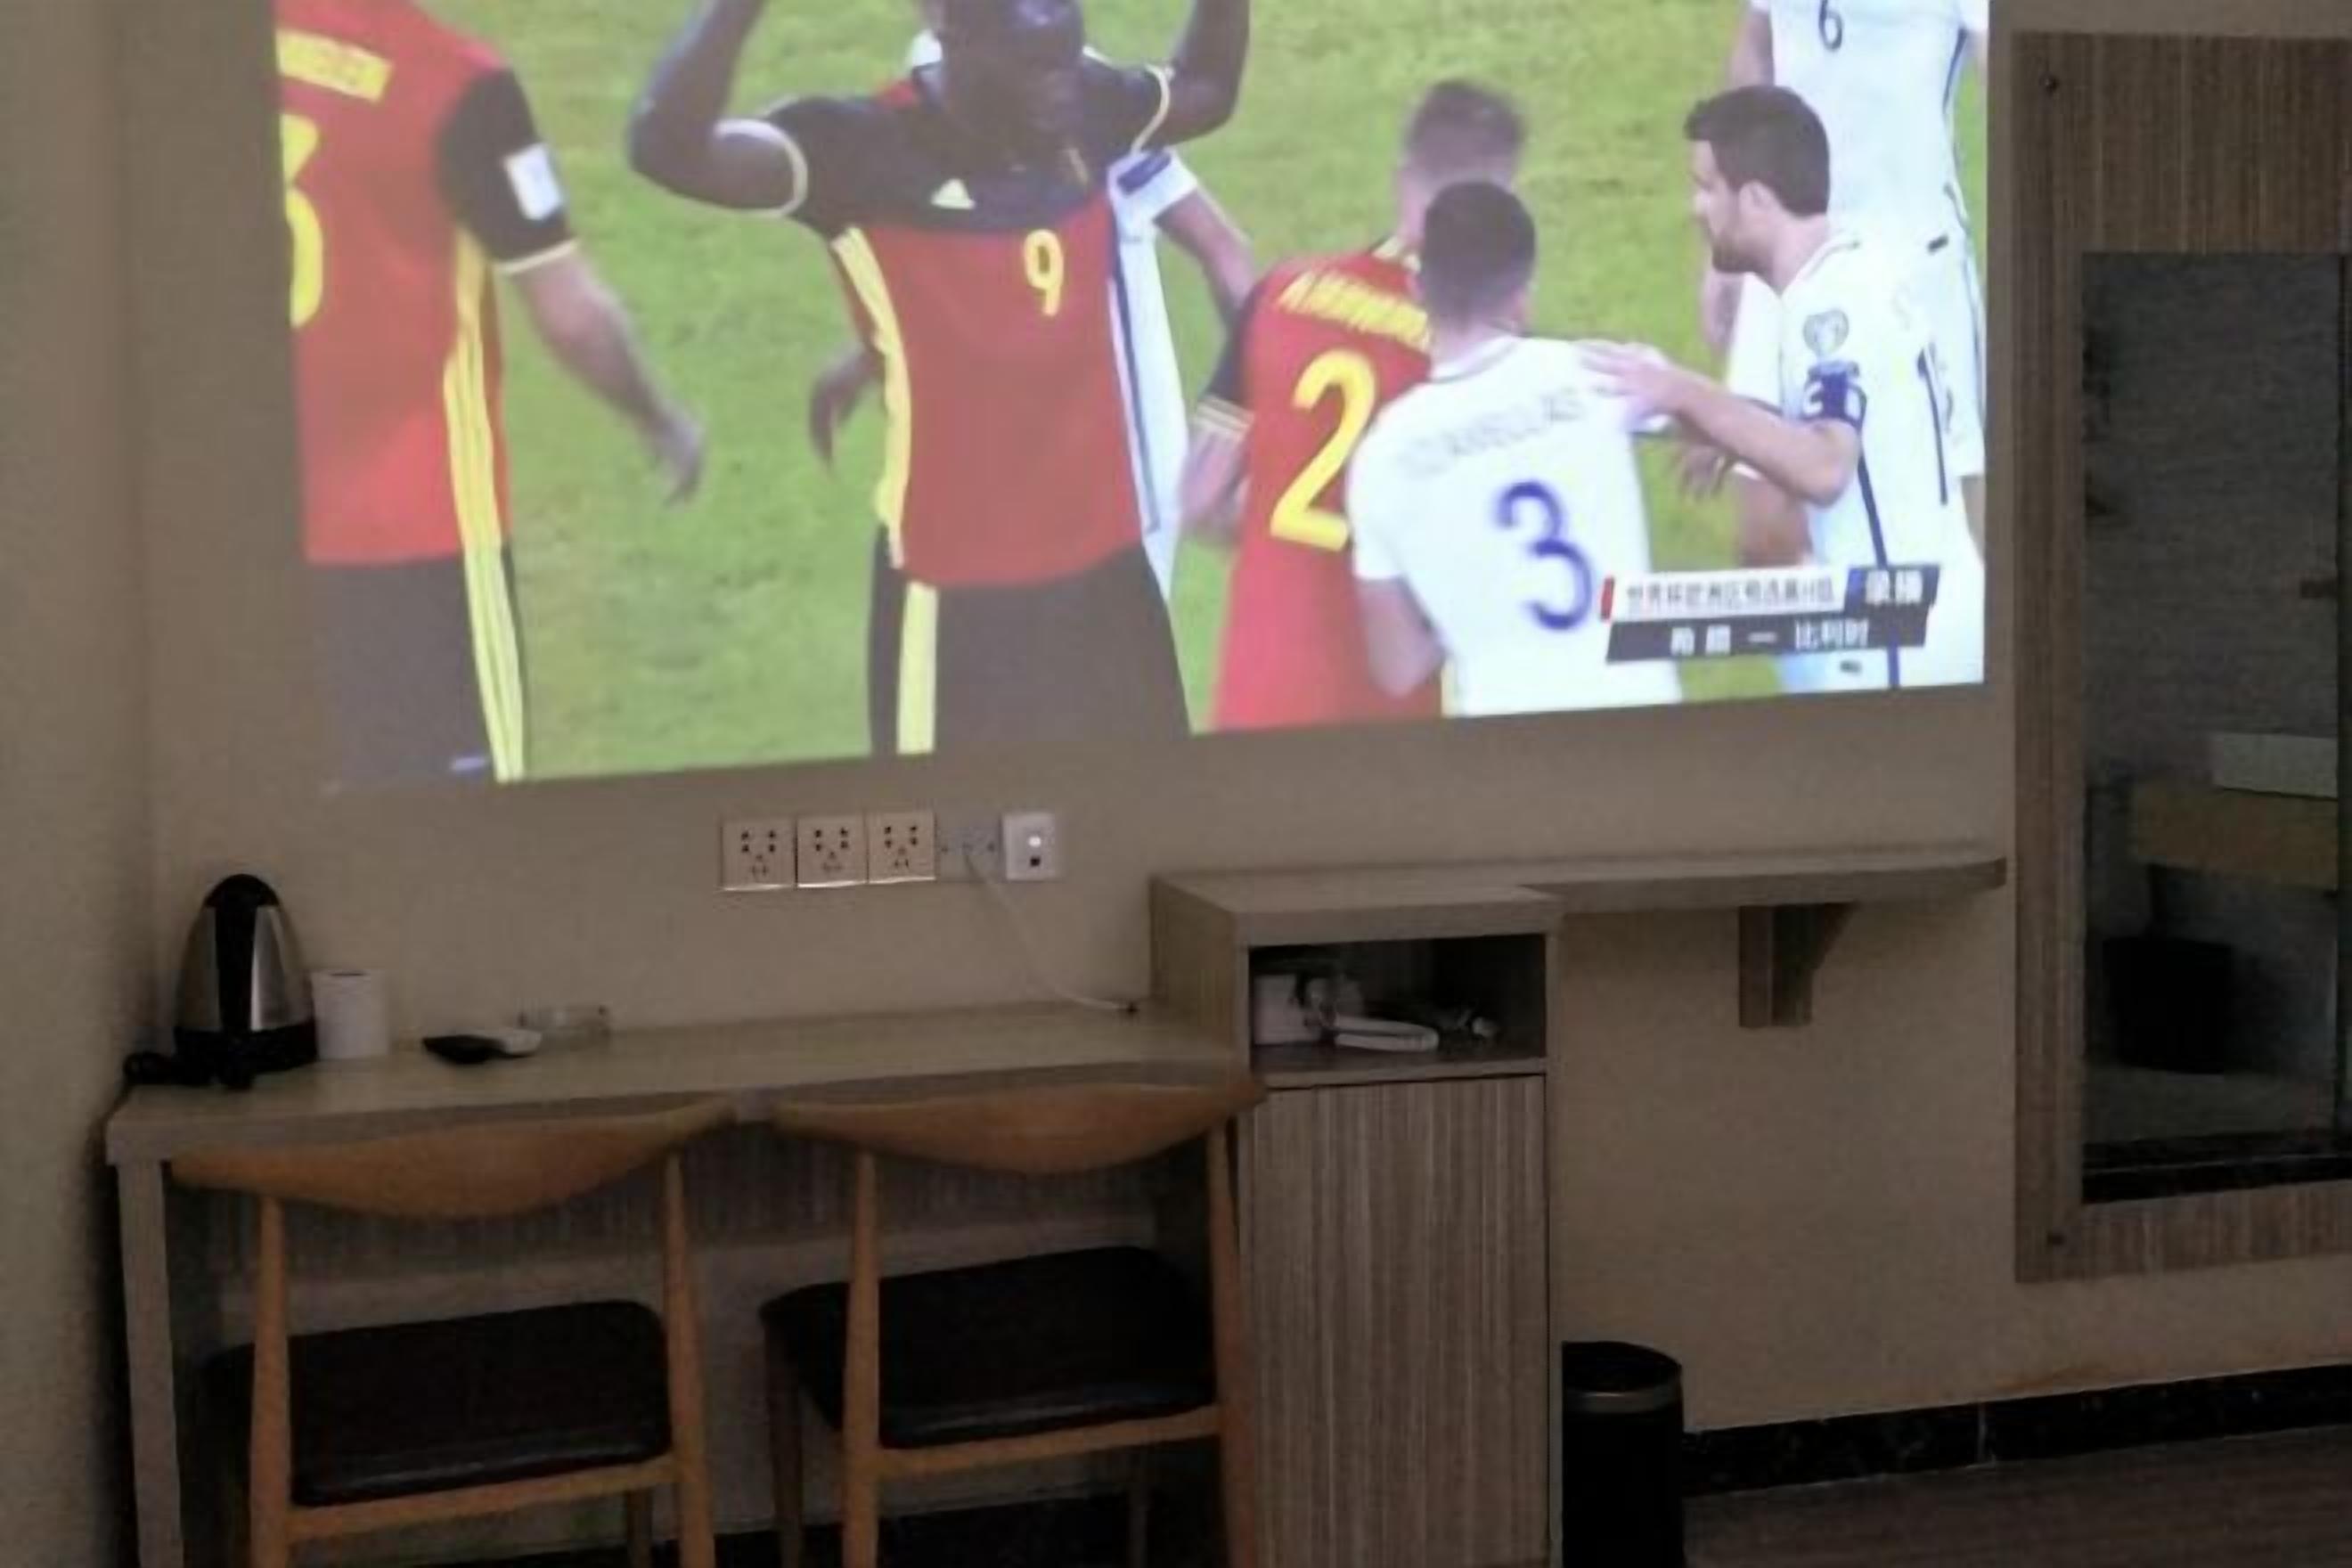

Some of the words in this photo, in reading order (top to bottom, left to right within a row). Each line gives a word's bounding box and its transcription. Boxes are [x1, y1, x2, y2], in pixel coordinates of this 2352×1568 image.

[1024, 228, 1065, 317] 9
[1270, 348, 1376, 552] 2
[1494, 477, 1593, 631] 3
